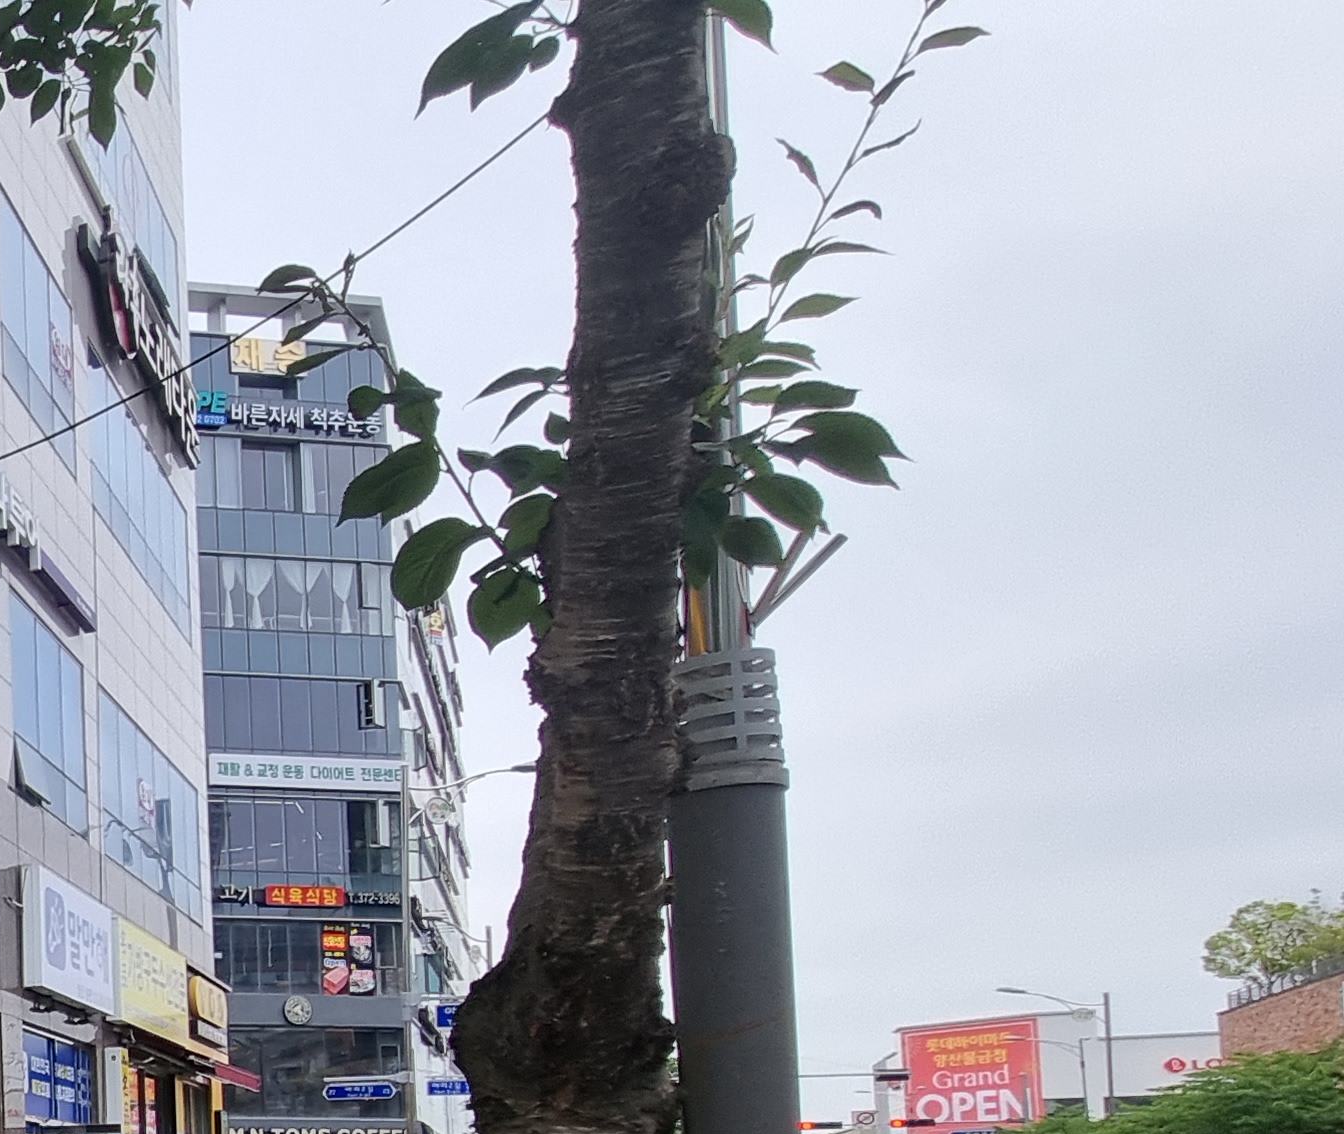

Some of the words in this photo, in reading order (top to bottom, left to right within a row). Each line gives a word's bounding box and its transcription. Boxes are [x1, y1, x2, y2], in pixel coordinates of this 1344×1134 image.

[231, 402, 305, 430] 바른자세
[244, 763, 254, 777] &
[310, 765, 356, 781] 다이어트
[219, 883, 253, 905] 고기
[271, 886, 338, 906] 식육식당
[932, 1063, 1010, 1089] Grand
[915, 1088, 1034, 1124] OPEN
